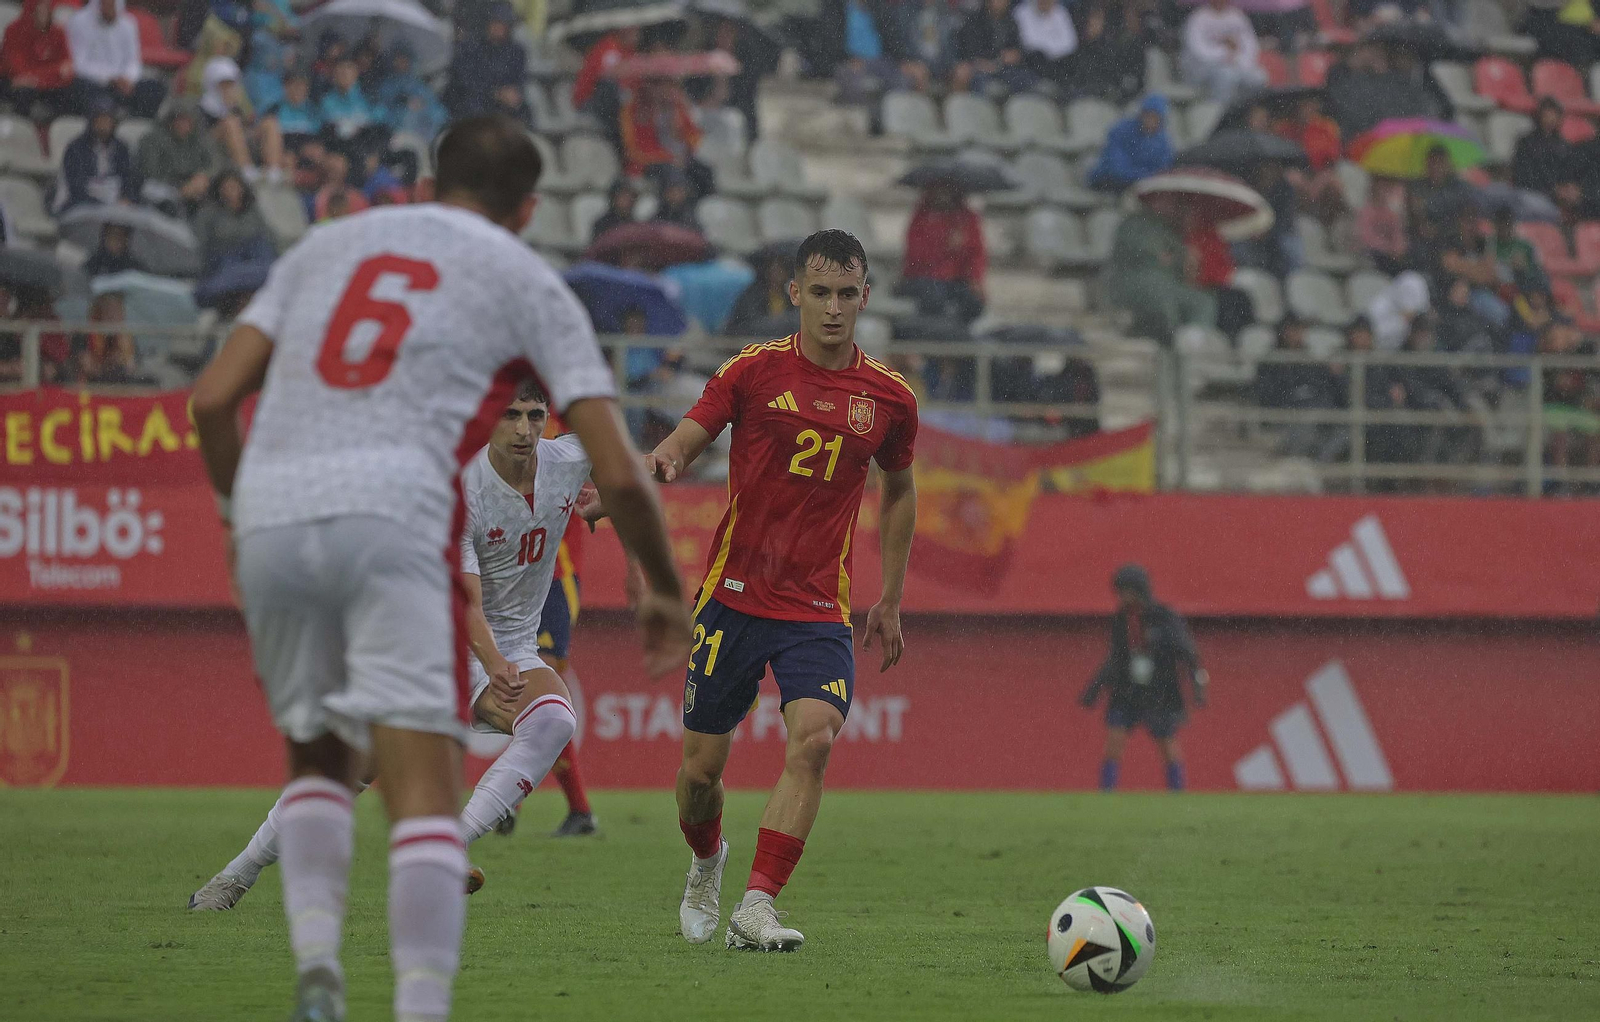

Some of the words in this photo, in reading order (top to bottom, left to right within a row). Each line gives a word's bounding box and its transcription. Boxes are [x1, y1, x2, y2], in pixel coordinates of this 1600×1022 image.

[316, 253, 440, 389] 6
[789, 429, 843, 481] 21
[518, 527, 547, 566] 10
[688, 623, 724, 677] 21
